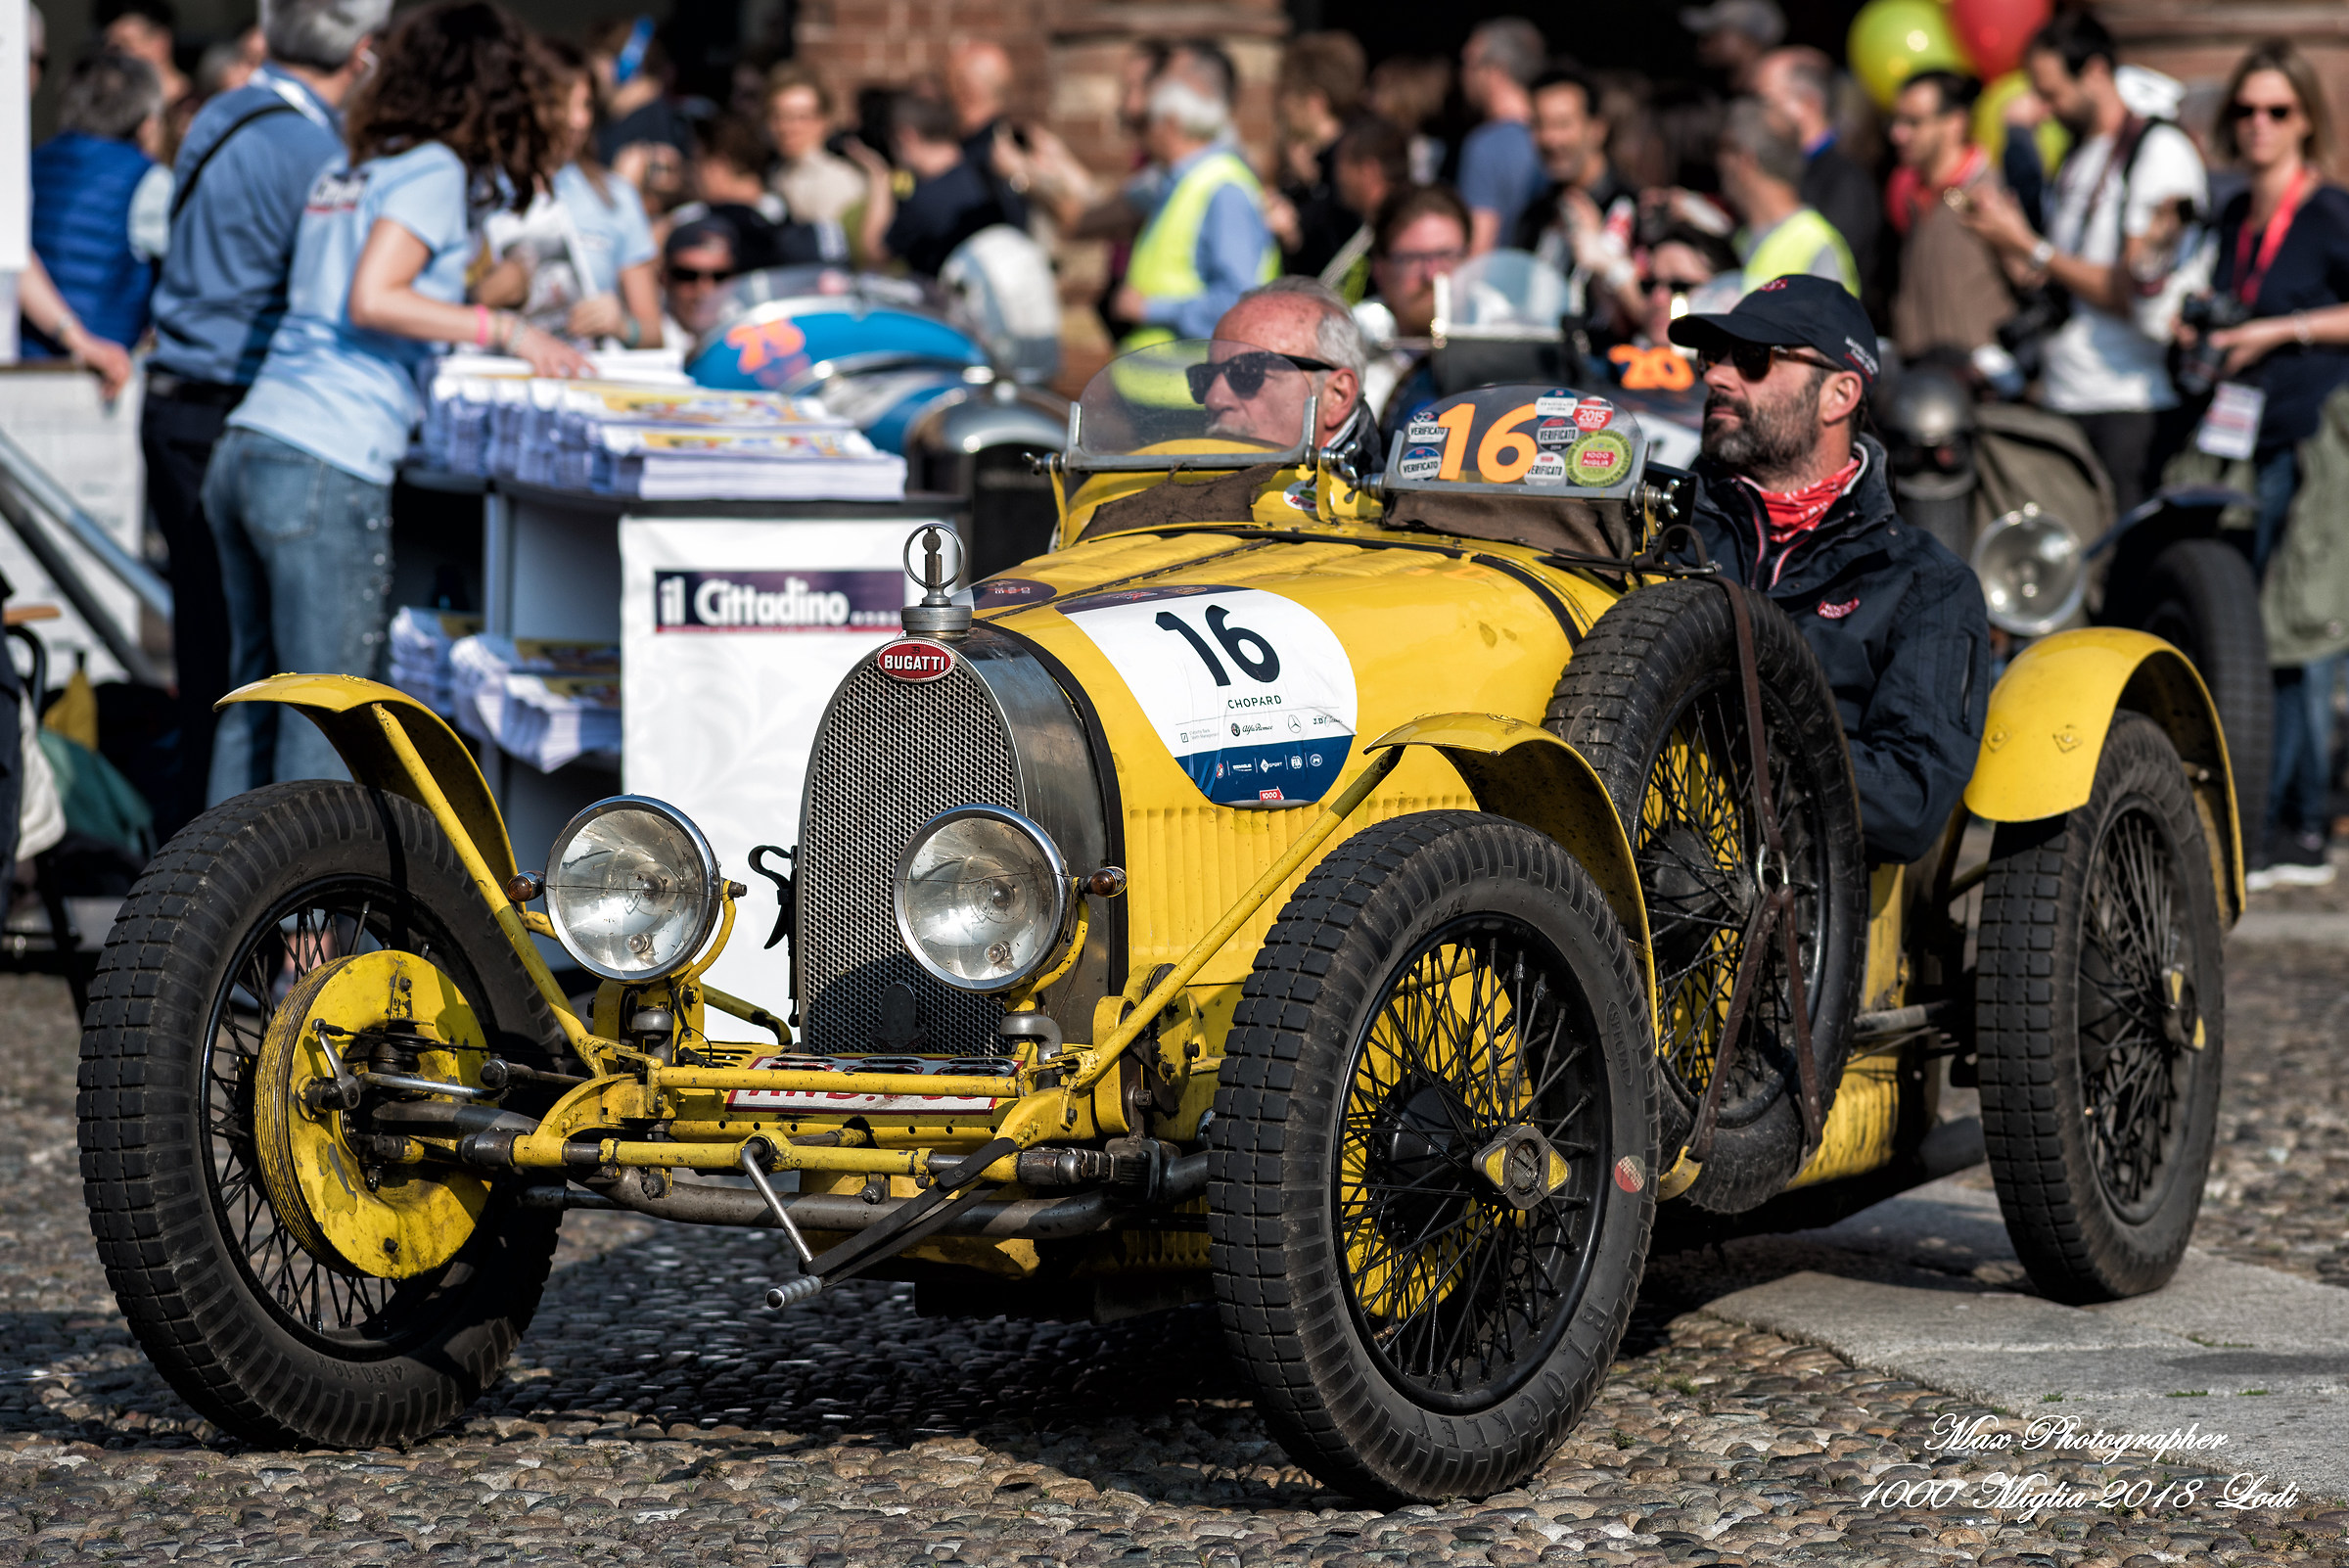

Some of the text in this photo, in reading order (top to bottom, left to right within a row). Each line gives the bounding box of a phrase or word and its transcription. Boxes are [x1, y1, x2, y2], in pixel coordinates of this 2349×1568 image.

[1607, 344, 1695, 392] 20
[1578, 409, 1606, 424] 2015
[1410, 426, 1445, 436] VERIFICATO
[1540, 429, 1576, 440] VERIFICATO
[1438, 402, 1538, 484] 16
[1403, 461, 1439, 474] VERIFICATO
[693, 576, 852, 626] Cittadino
[1155, 604, 1280, 687] 16
[884, 654, 946, 671] BUGATTI
[1226, 694, 1282, 710] CHOPARD
[1262, 791, 1278, 800] 1000
[1417, 1301, 1609, 1449] BLOCKLEY
